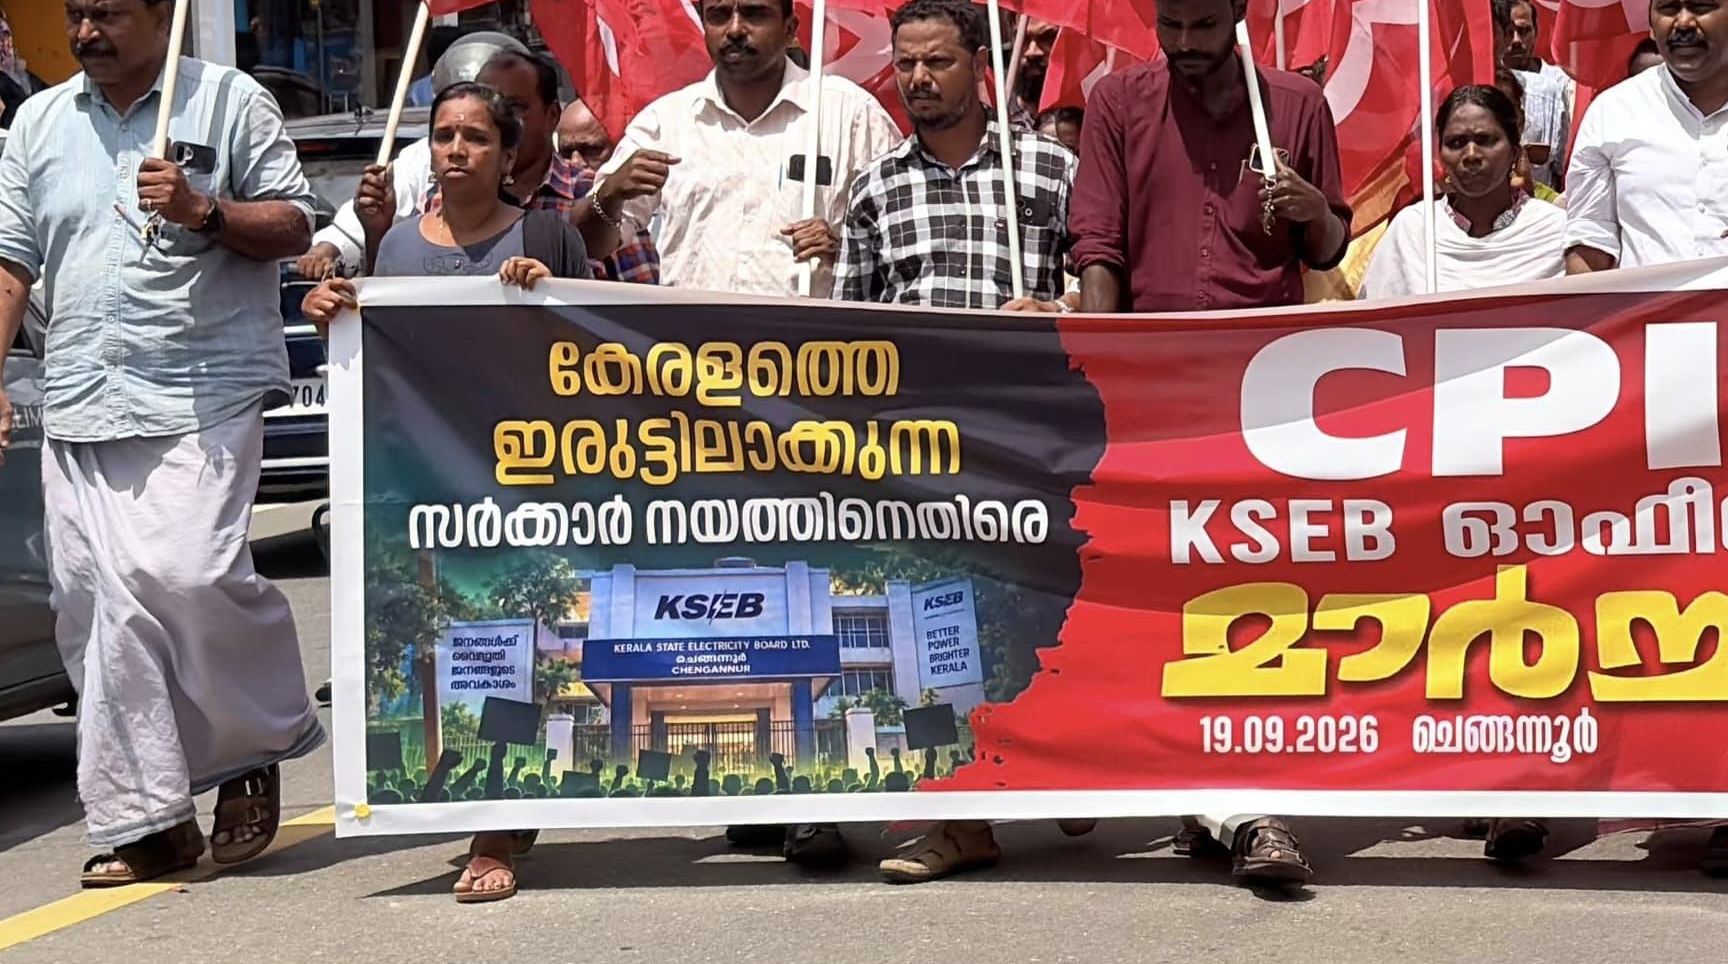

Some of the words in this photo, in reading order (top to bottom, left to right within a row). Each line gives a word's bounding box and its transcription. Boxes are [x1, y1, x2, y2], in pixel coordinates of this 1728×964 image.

[548, 339, 900, 408] കേരളത്തെ
[1240, 321, 1721, 480] CPI
[493, 410, 961, 487] ഇരുട്ടിലാക്കുന്ന
[408, 495, 632, 550] സർക്കാർ
[646, 491, 1050, 546] നയത്തിനെതിരെ
[1170, 499, 1396, 565] KSEB
[654, 591, 766, 623] KSEB
[923, 591, 964, 611] KSEB
[926, 625, 960, 640] BETTER
[613, 643, 653, 653] KERALA
[656, 642, 685, 652] STATE
[688, 641, 750, 652] ELECTRICITY
[754, 640, 788, 650] BOARD
[791, 639, 811, 650] LTD.
[927, 637, 960, 651] POWER
[676, 653, 748, 665] ചെങ്ങന്നൂർ
[929, 648, 970, 664] BRIGHTER
[671, 664, 751, 675] CHENGANNUR
[930, 661, 968, 676] KERALA
[1199, 714, 1379, 755] 19.09.2026
[1411, 708, 1599, 763] ചെങ്ങന്നൂർ
